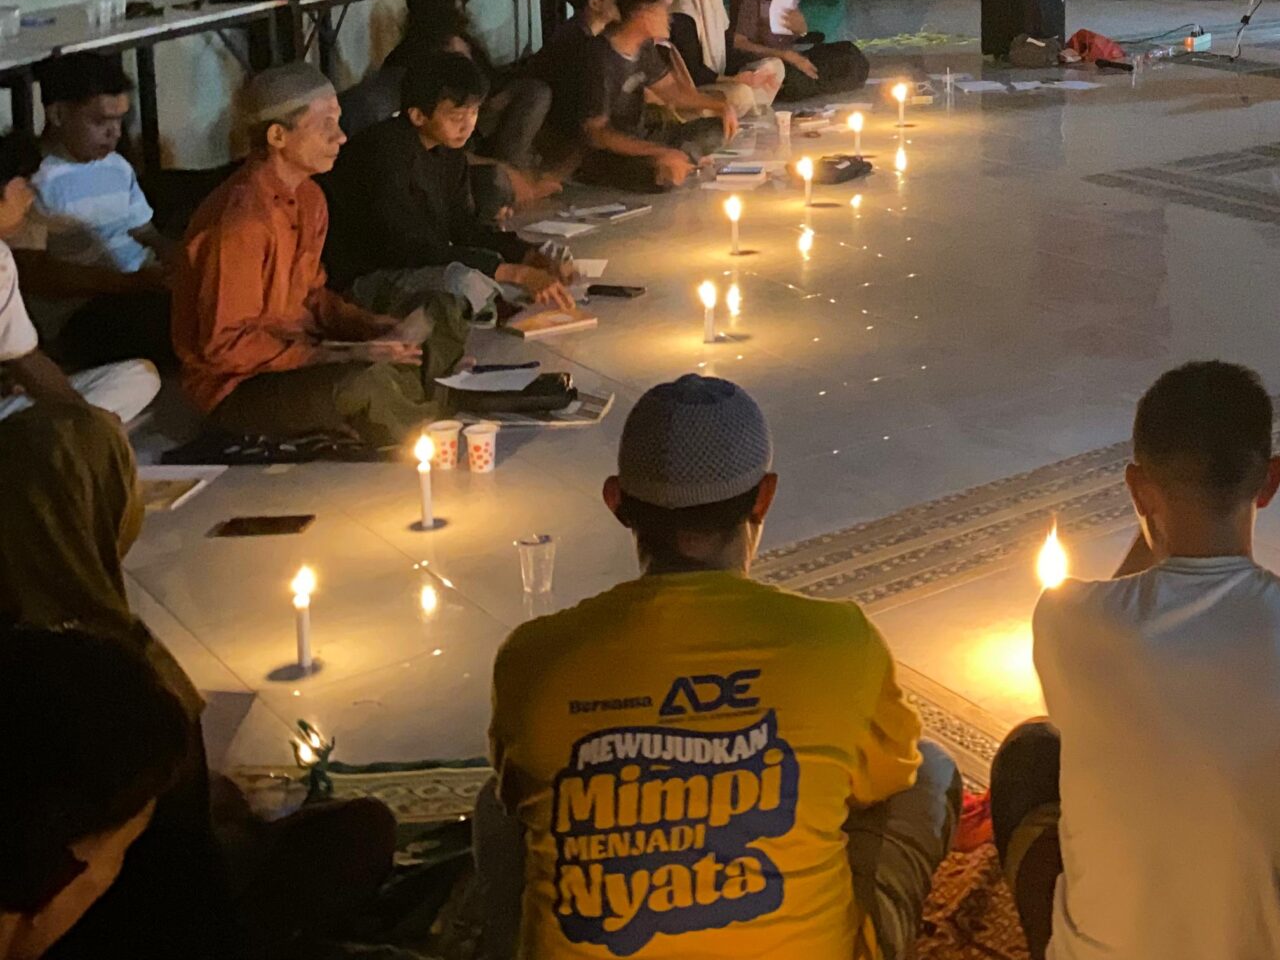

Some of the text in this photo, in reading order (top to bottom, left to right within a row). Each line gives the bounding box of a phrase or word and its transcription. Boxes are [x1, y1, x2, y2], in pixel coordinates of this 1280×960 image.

[659, 668, 761, 716] ADE
[577, 723, 768, 770] MEWUJUDKAN
[556, 747, 784, 832] Mimpi
[564, 824, 705, 861] MENJADI
[559, 852, 767, 932] Nyata
